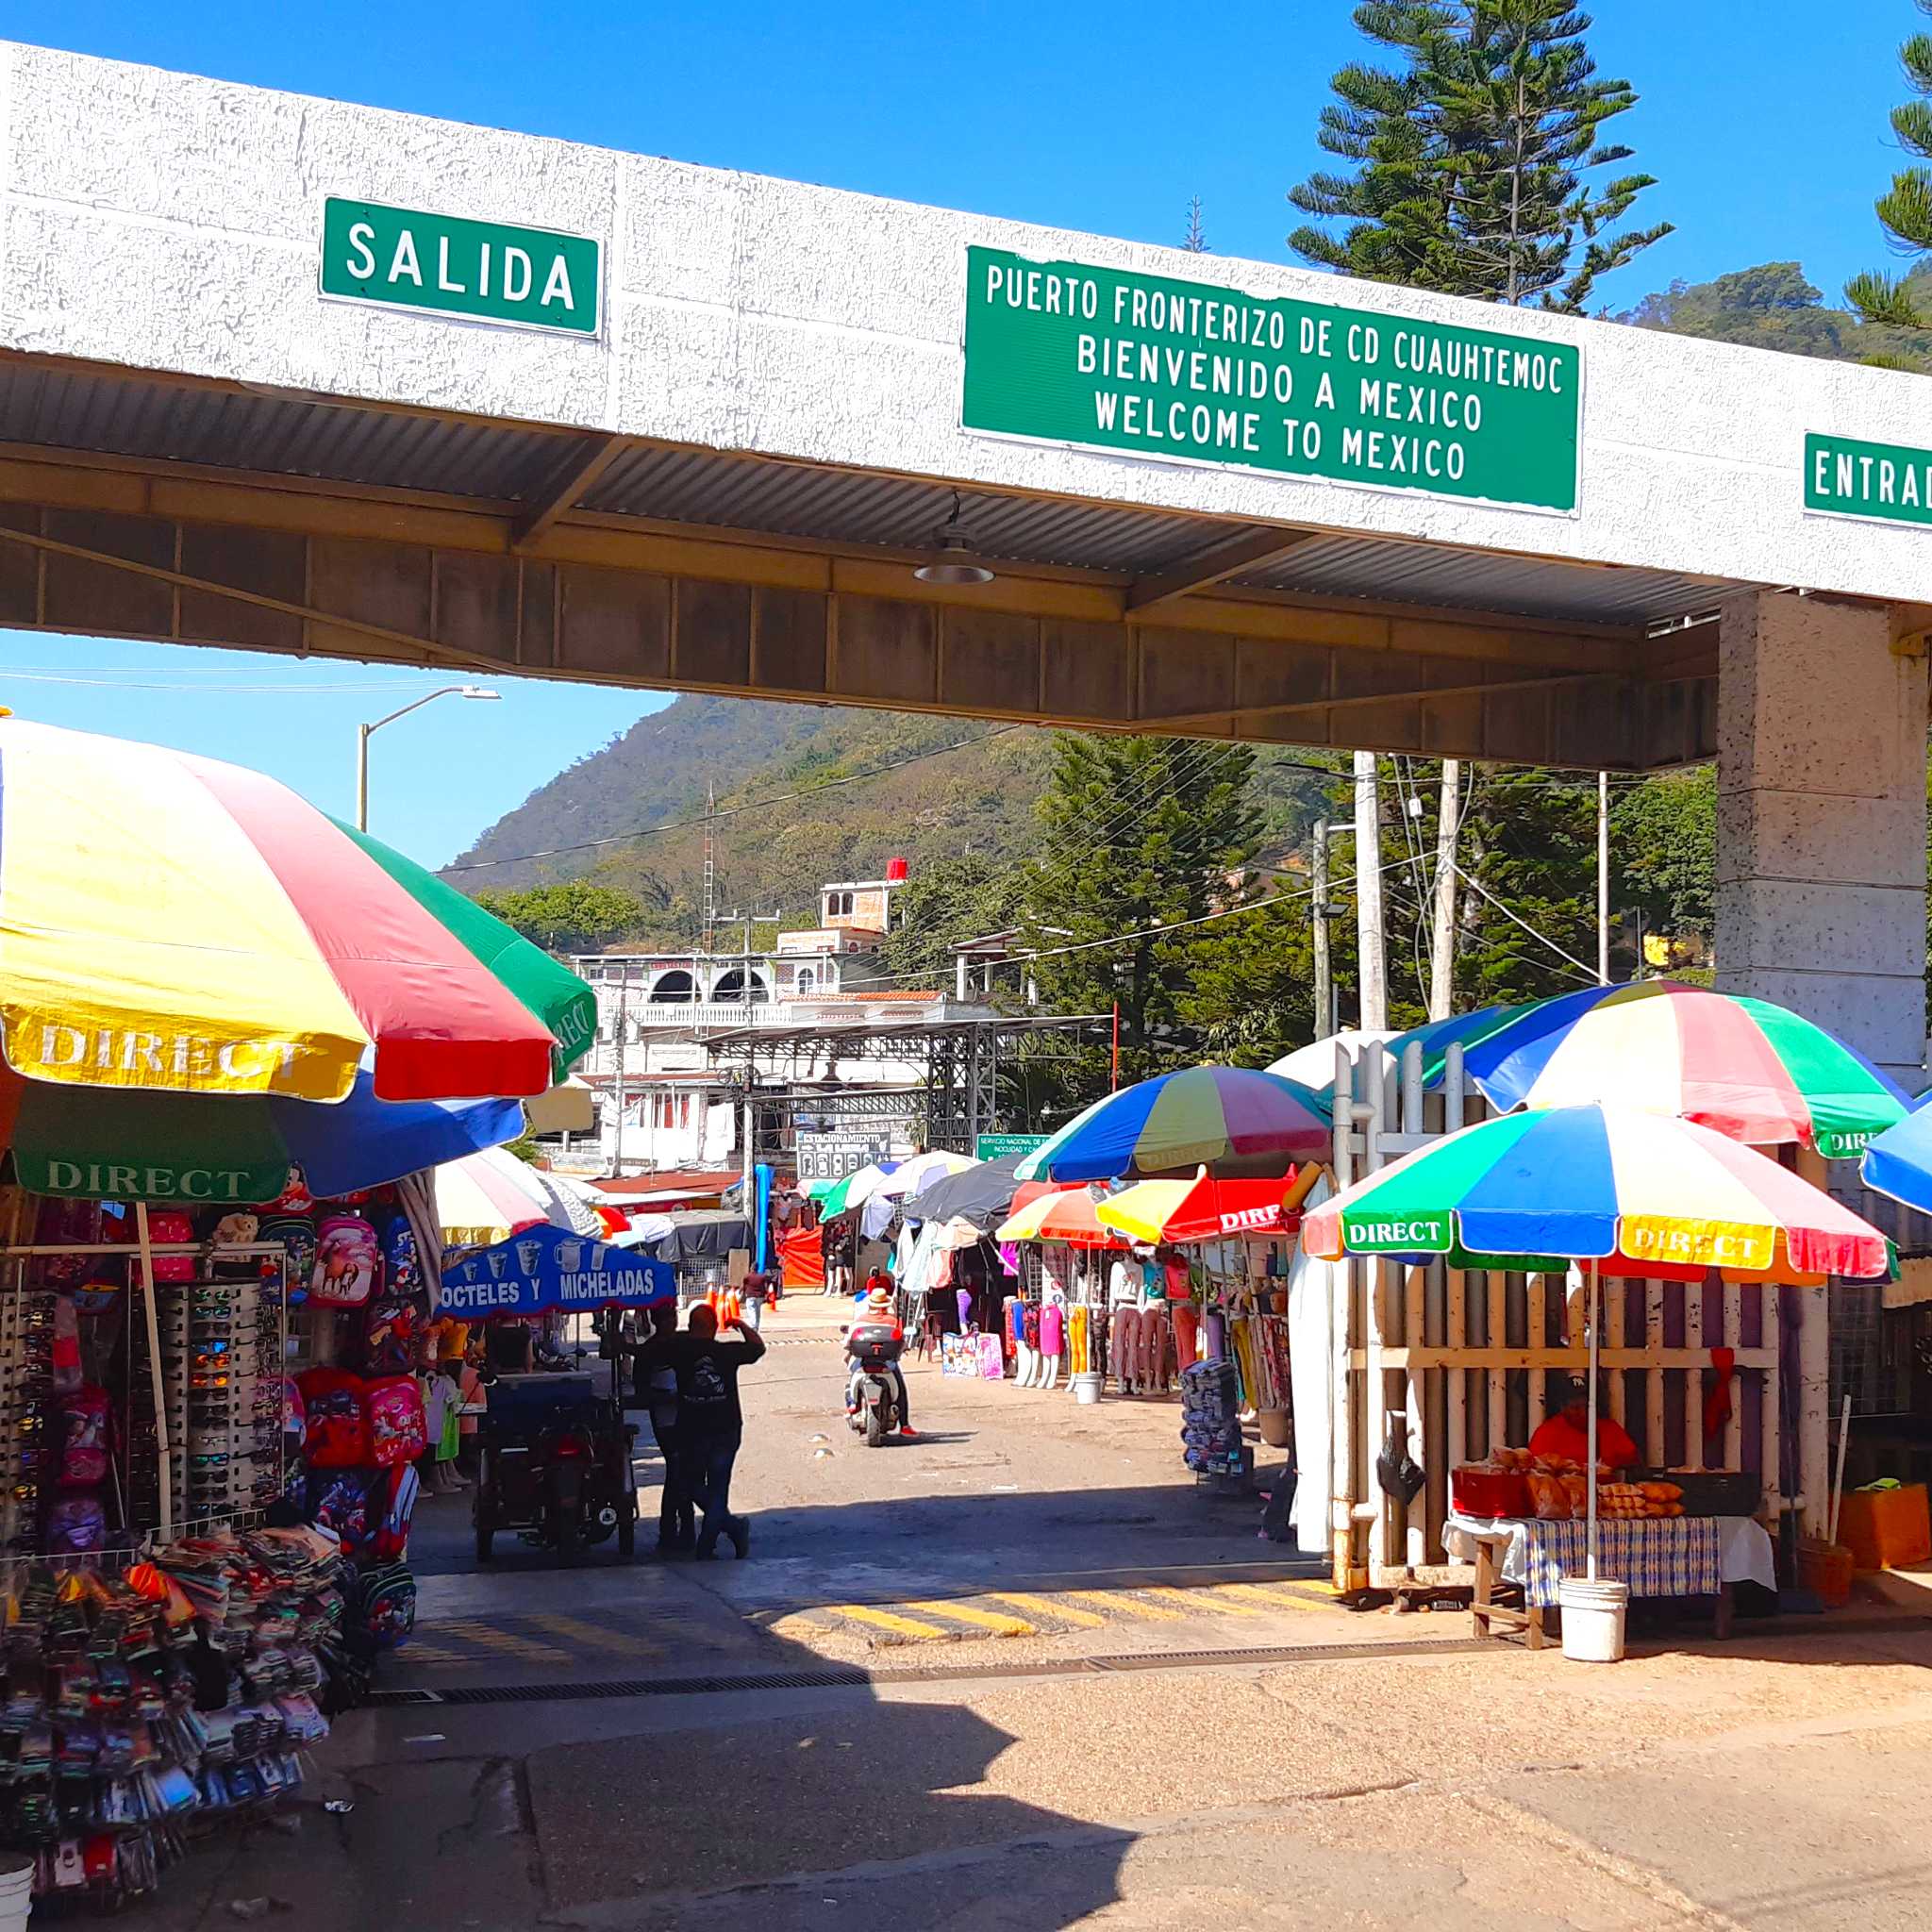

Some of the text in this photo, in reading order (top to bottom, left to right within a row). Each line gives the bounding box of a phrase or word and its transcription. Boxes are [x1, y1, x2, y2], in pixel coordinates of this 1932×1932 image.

[346, 223, 575, 309] SALIDA
[987, 265, 1562, 393] PUERTO FRONTERIZO DE CD CUAUHTEMOC
[1077, 334, 1482, 432] BIENVENIDO A MEXICO
[1094, 391, 1465, 480] WELCOME TO MEXICO
[1815, 450, 1932, 508] ENTRA
[39, 1024, 317, 1078] DIRECT
[804, 1134, 880, 1143] ESTACIONAMIENTO
[1831, 1132, 1877, 1150] DIR
[47, 1161, 249, 1197] DIRECT
[1220, 1204, 1280, 1230] DIRE
[1349, 1221, 1441, 1243] DIRECT
[1635, 1228, 1758, 1257] DIRECT
[441, 1268, 654, 1307] OCTELES Y MICHELADAS
